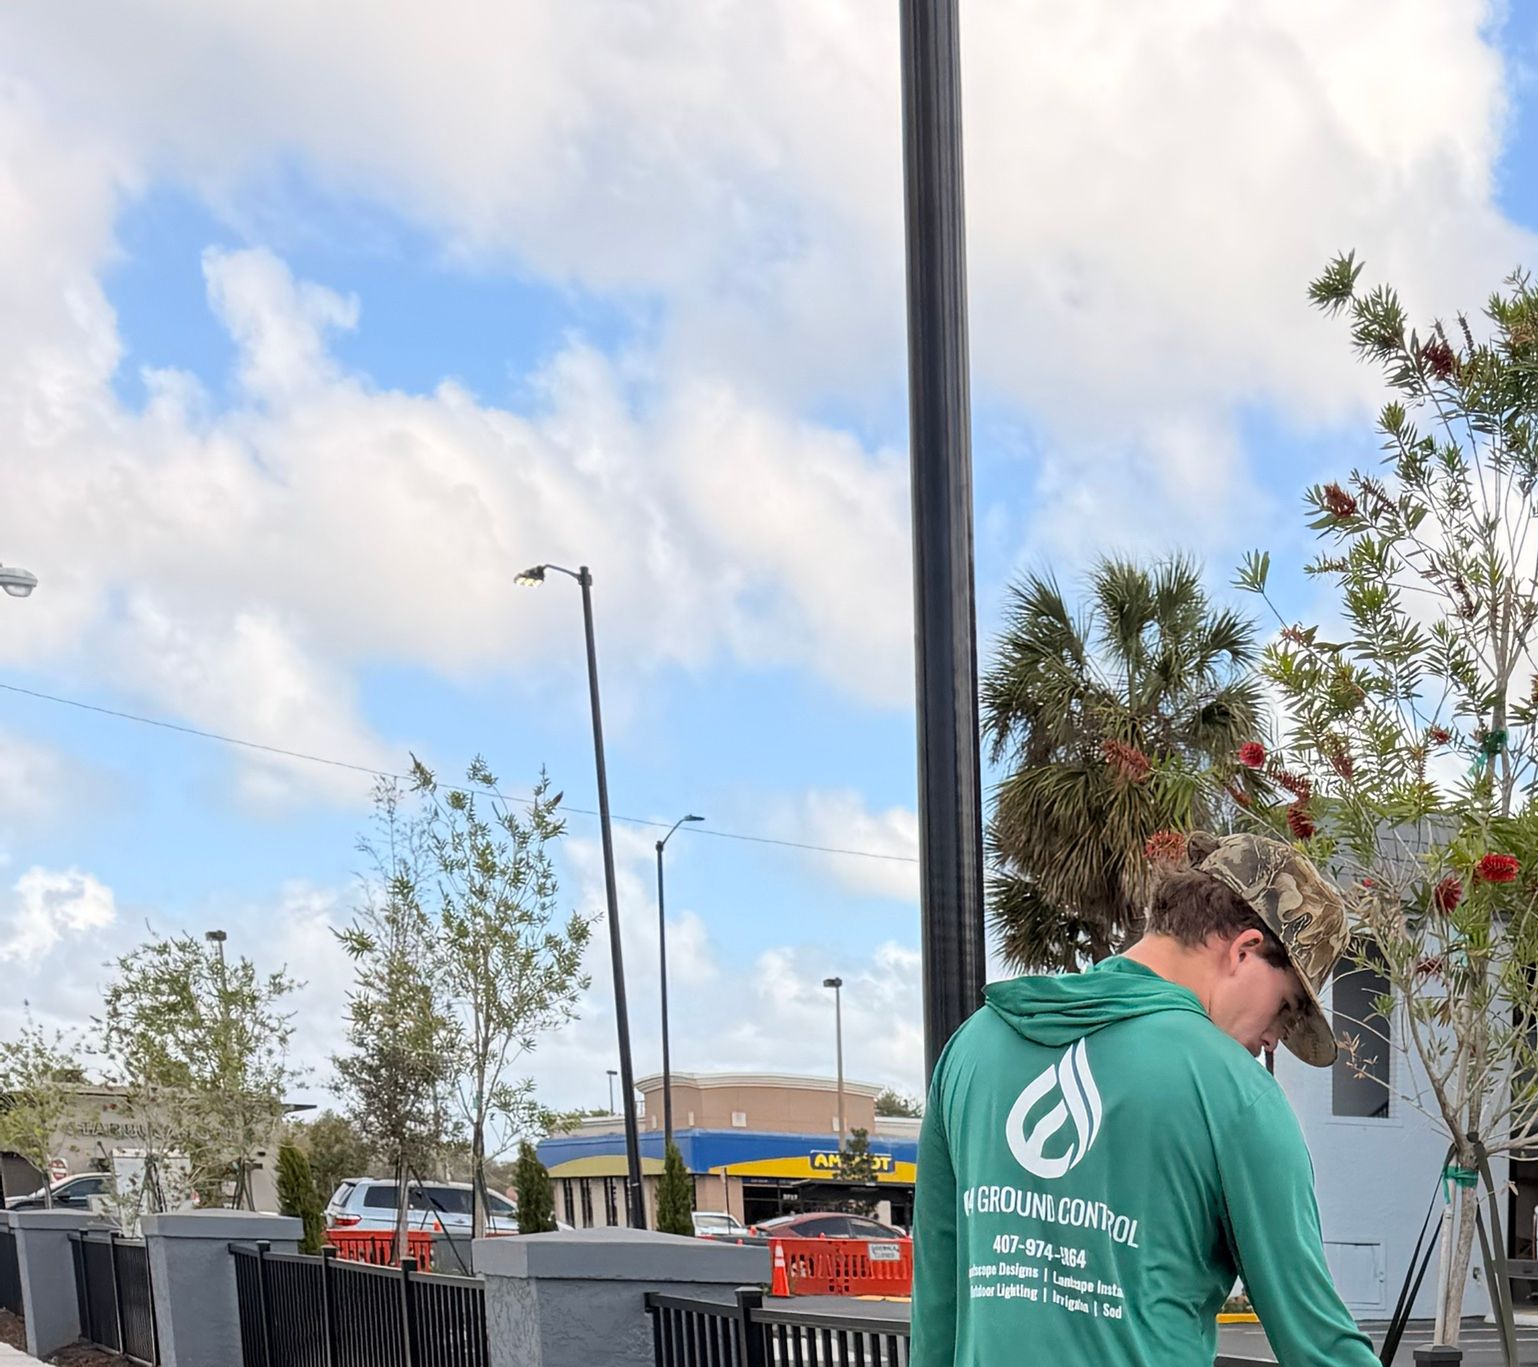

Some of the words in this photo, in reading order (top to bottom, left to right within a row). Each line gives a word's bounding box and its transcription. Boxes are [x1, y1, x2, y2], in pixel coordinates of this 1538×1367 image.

[814, 1153, 892, 1170] AMOT
[977, 1185, 1055, 1223] GROUND
[1058, 1197, 1139, 1249] CONTROL
[997, 1283, 1038, 1301] Lighting
[1103, 1303, 1122, 1319] Sod
